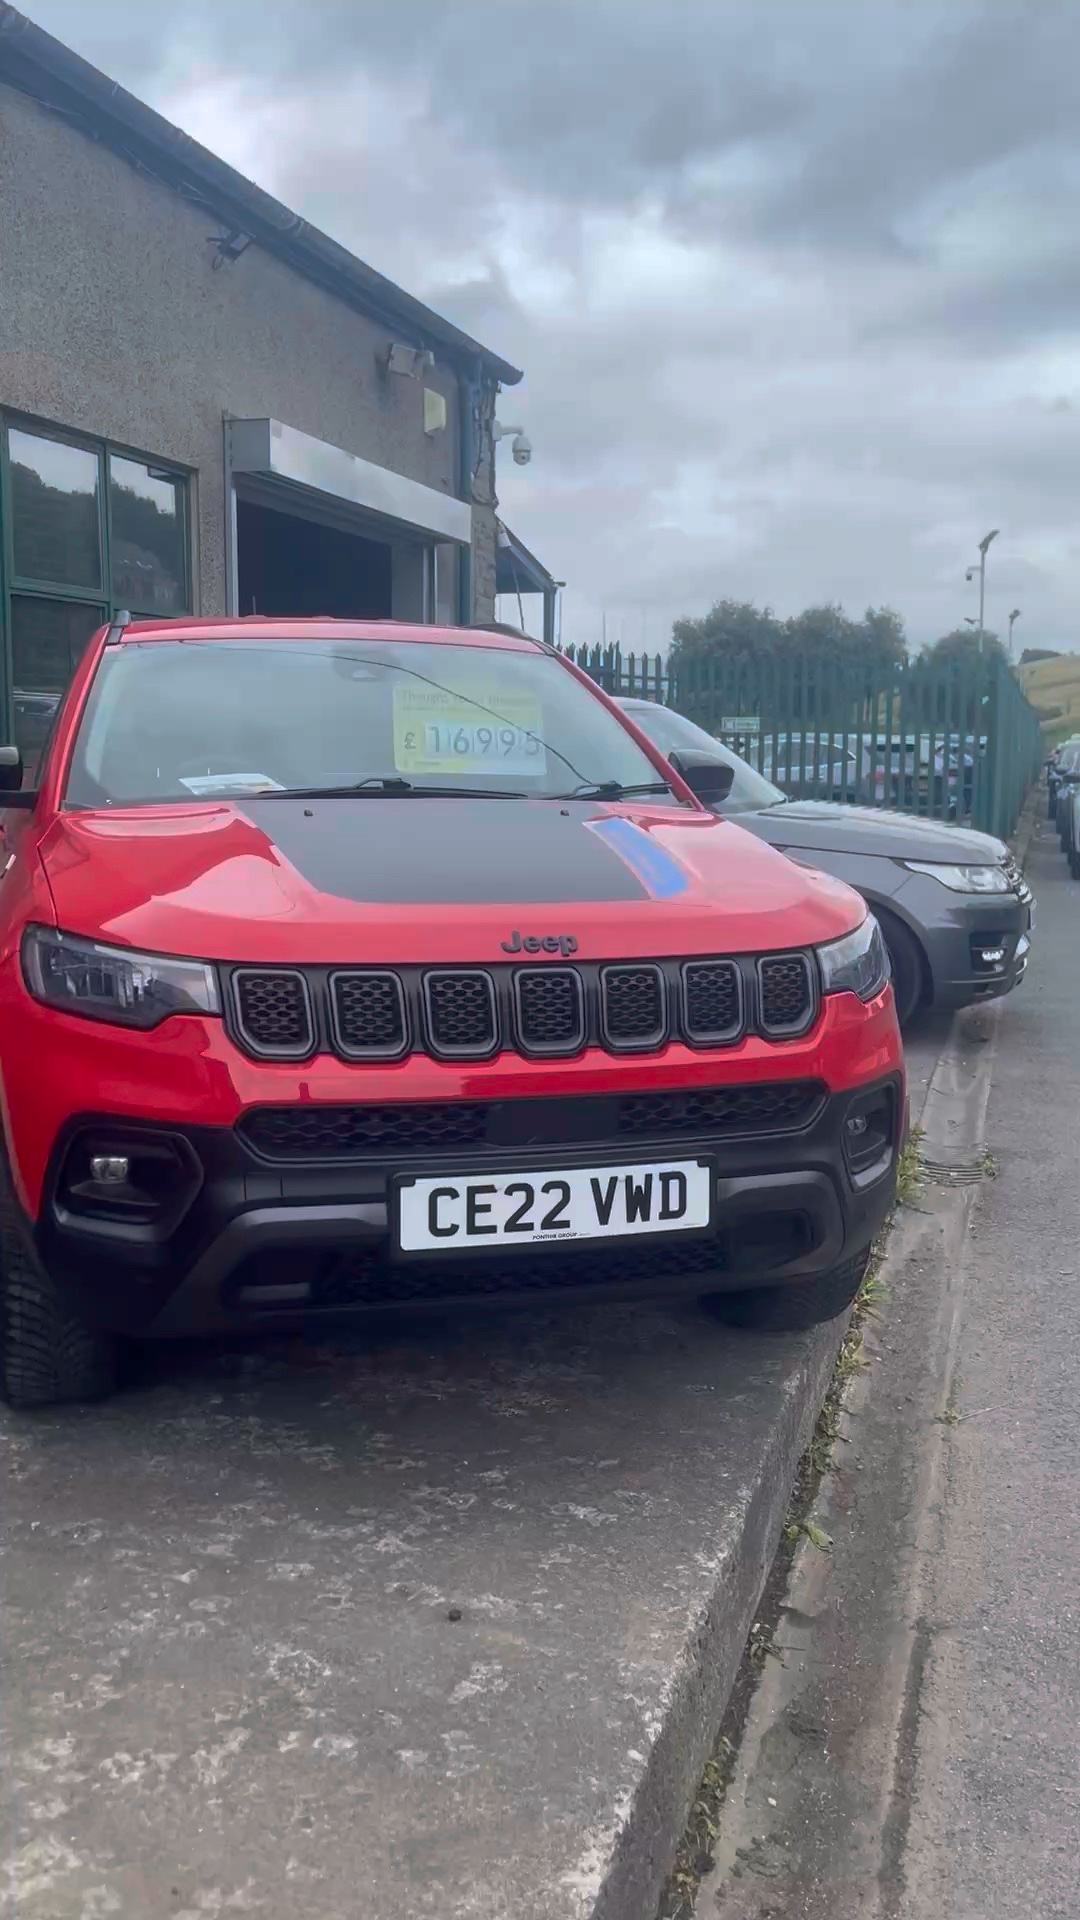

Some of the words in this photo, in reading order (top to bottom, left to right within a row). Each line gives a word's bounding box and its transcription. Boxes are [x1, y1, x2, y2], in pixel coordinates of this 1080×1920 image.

[501, 930, 578, 957] Jeep
[428, 1180, 571, 1238] CE22
[590, 1171, 687, 1226] VWD
